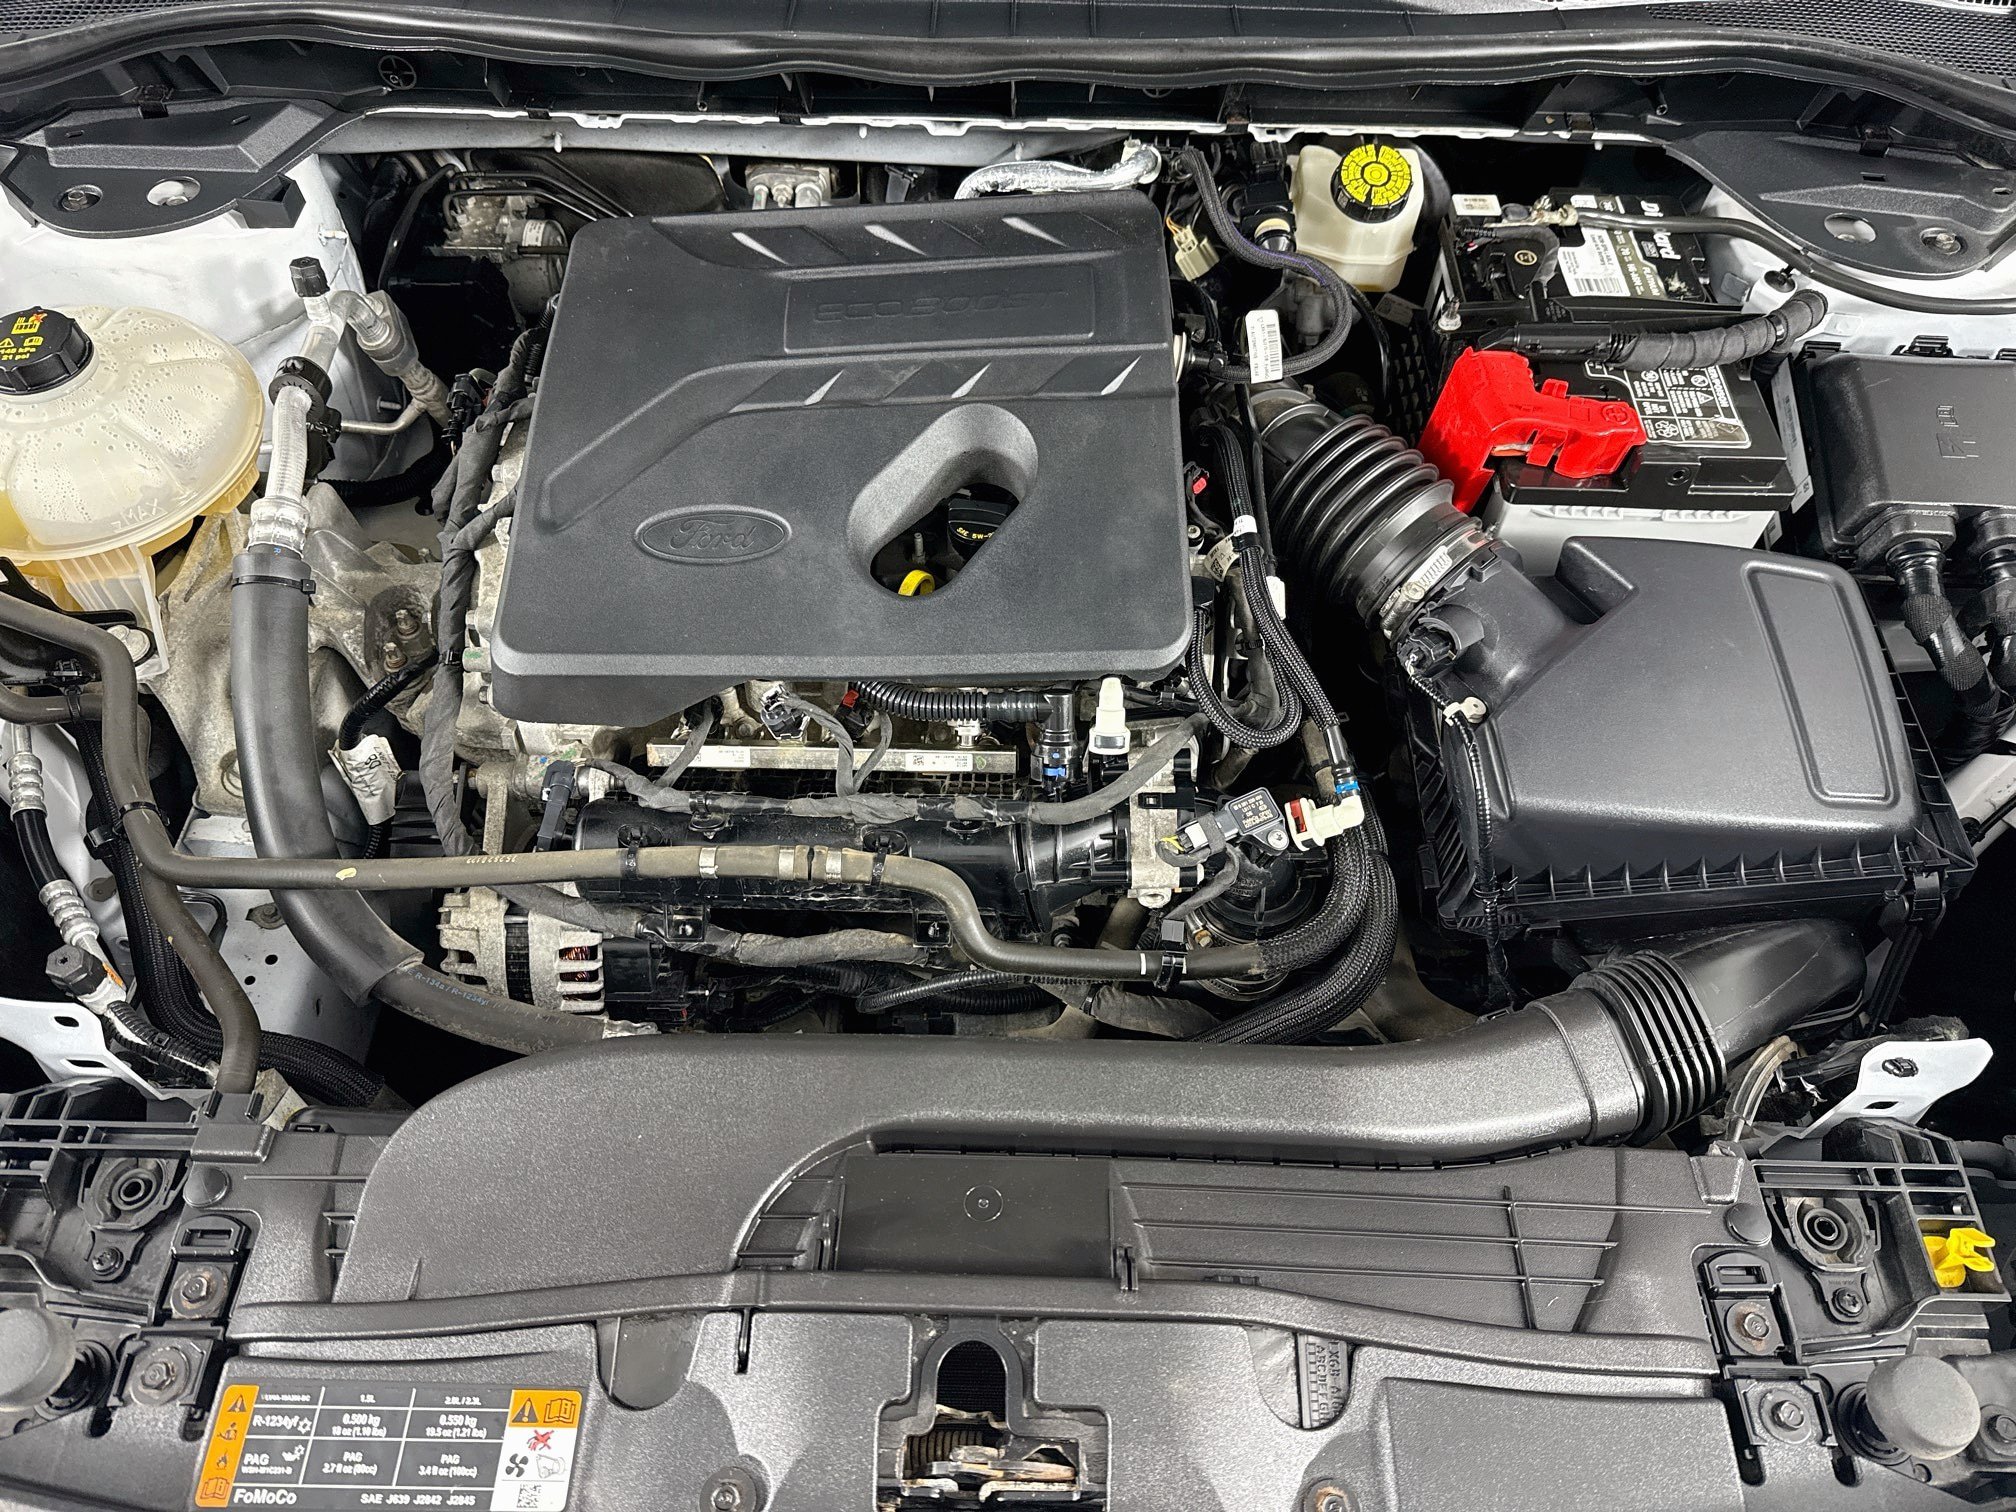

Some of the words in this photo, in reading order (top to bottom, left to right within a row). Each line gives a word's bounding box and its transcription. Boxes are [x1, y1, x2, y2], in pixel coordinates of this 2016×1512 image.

[119, 498, 158, 526] MAX
[669, 517, 757, 550] Ford
[252, 1414, 300, 1430] R-1234yf
[368, 1413, 381, 1427] kg
[464, 1415, 477, 1428] kg
[244, 1453, 270, 1466] PAG
[343, 1451, 363, 1462] PAG
[440, 1453, 460, 1464] PAG
[233, 1488, 297, 1505] FoMoCo
[360, 1493, 384, 1504] SAE
